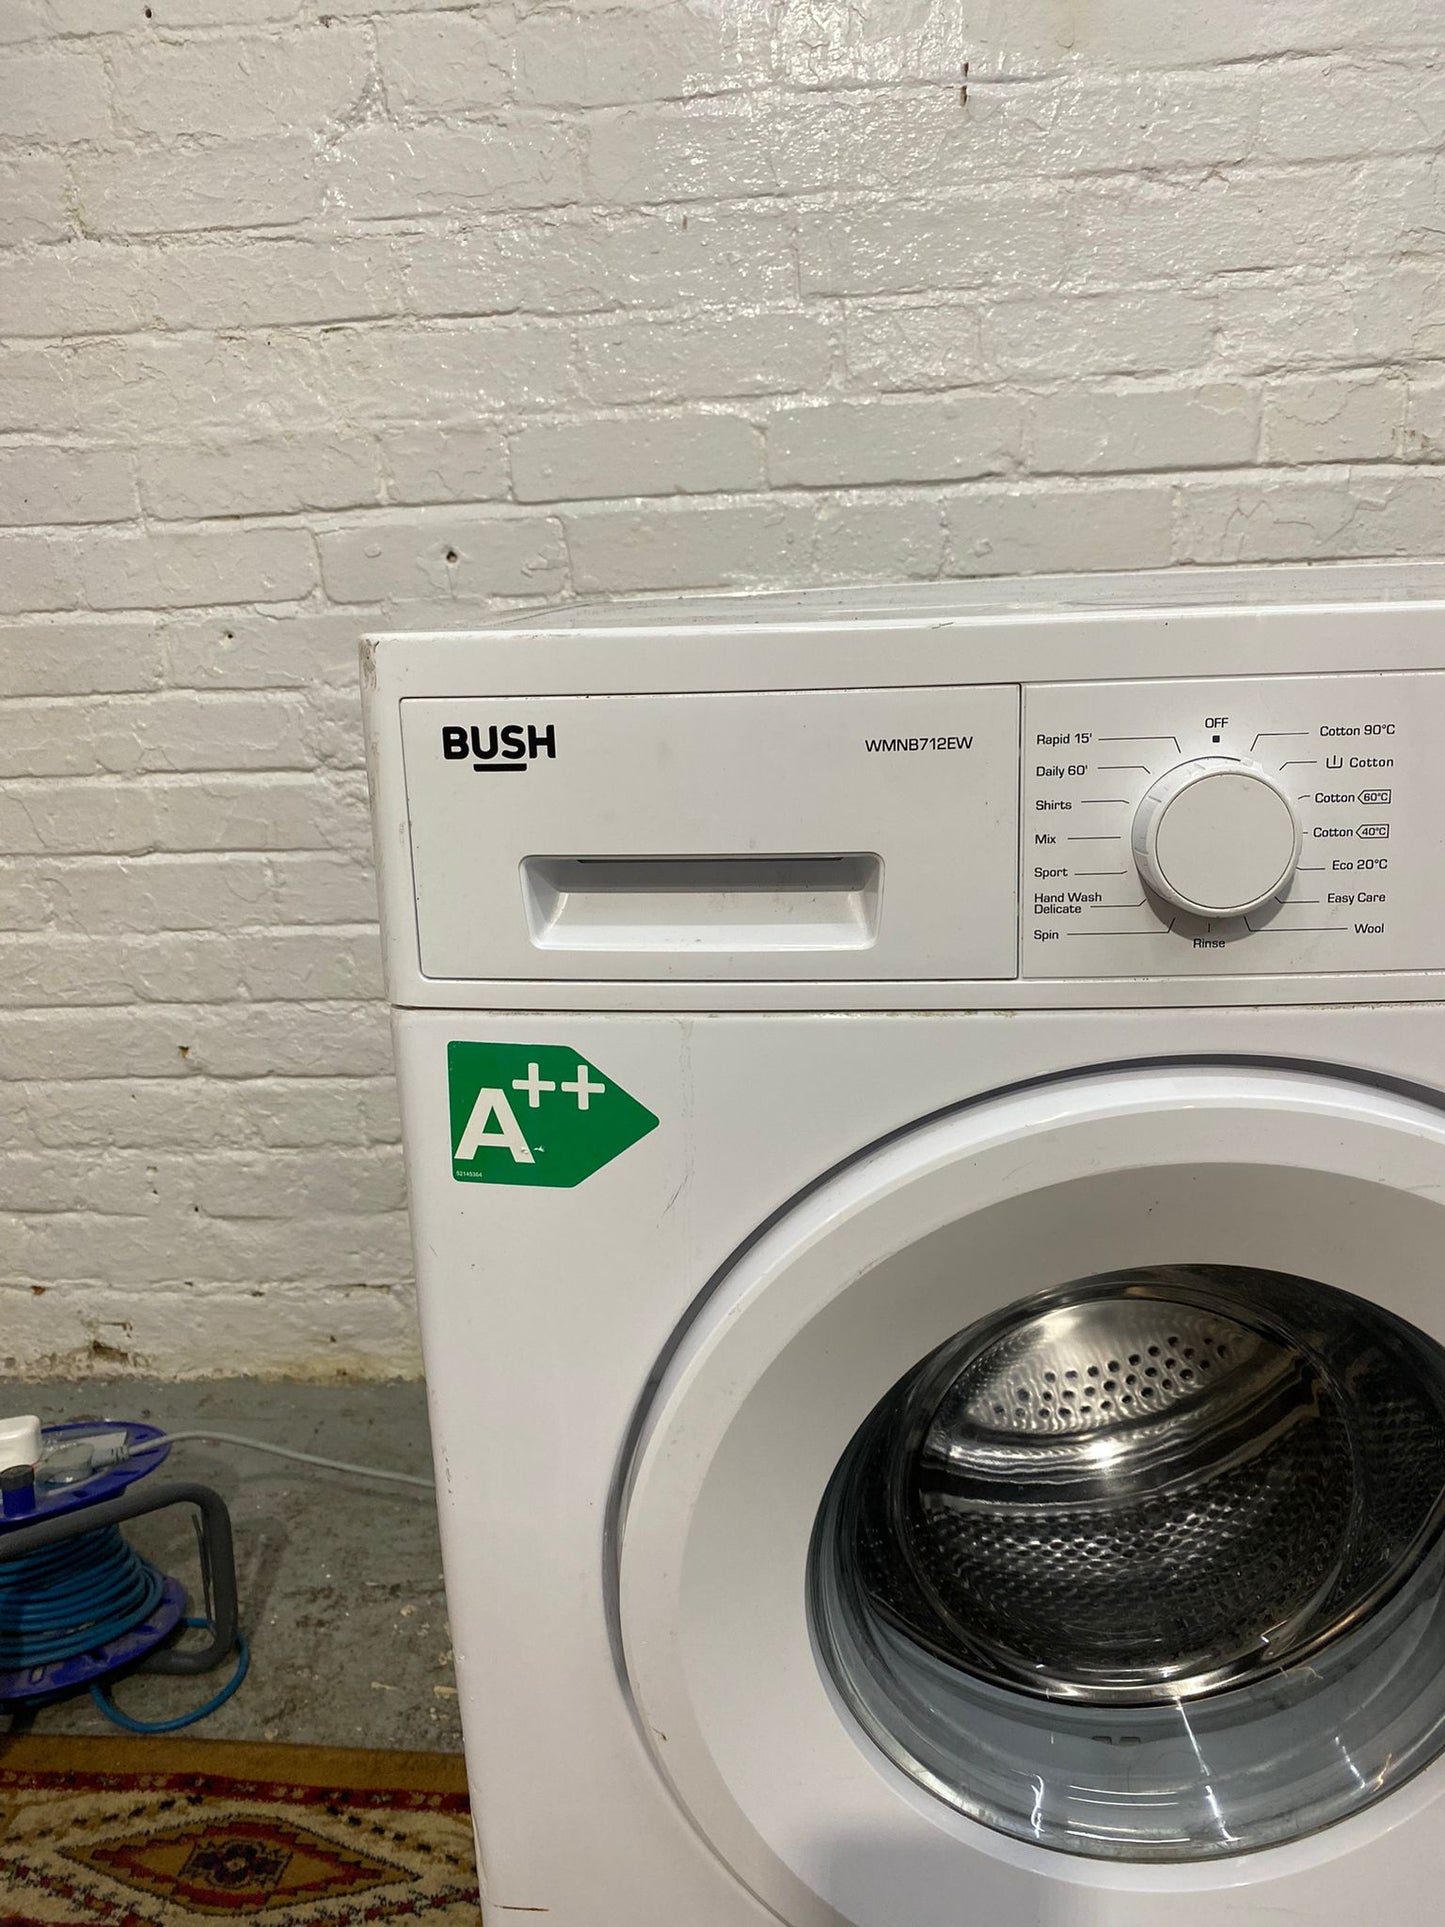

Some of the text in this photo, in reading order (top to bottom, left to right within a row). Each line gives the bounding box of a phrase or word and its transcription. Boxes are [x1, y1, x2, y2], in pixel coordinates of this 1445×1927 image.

[1204, 718, 1229, 729] OFF
[1320, 724, 1395, 737] Cotton 90°C
[442, 724, 557, 760] BUSH
[864, 736, 974, 753] WMNB712EW
[1036, 733, 1070, 746] Rapid
[1349, 757, 1394, 768] Cotton
[1036, 766, 1065, 779] Daily
[1315, 792, 1388, 803] Cotton 60°C
[1035, 800, 1072, 811] Shirts
[1313, 826, 1386, 837] Cotton 40°C
[1035, 834, 1057, 844] Mix
[1332, 858, 1388, 871] Eco 20°C
[1034, 867, 1068, 879] Sport
[1034, 892, 1102, 903] Hand Wash
[1327, 892, 1386, 905] Easy Care
[1034, 904, 1082, 914] Delicate
[1354, 923, 1385, 934] Wool
[1034, 930, 1059, 941] Spin
[1193, 938, 1226, 949] Rinse
